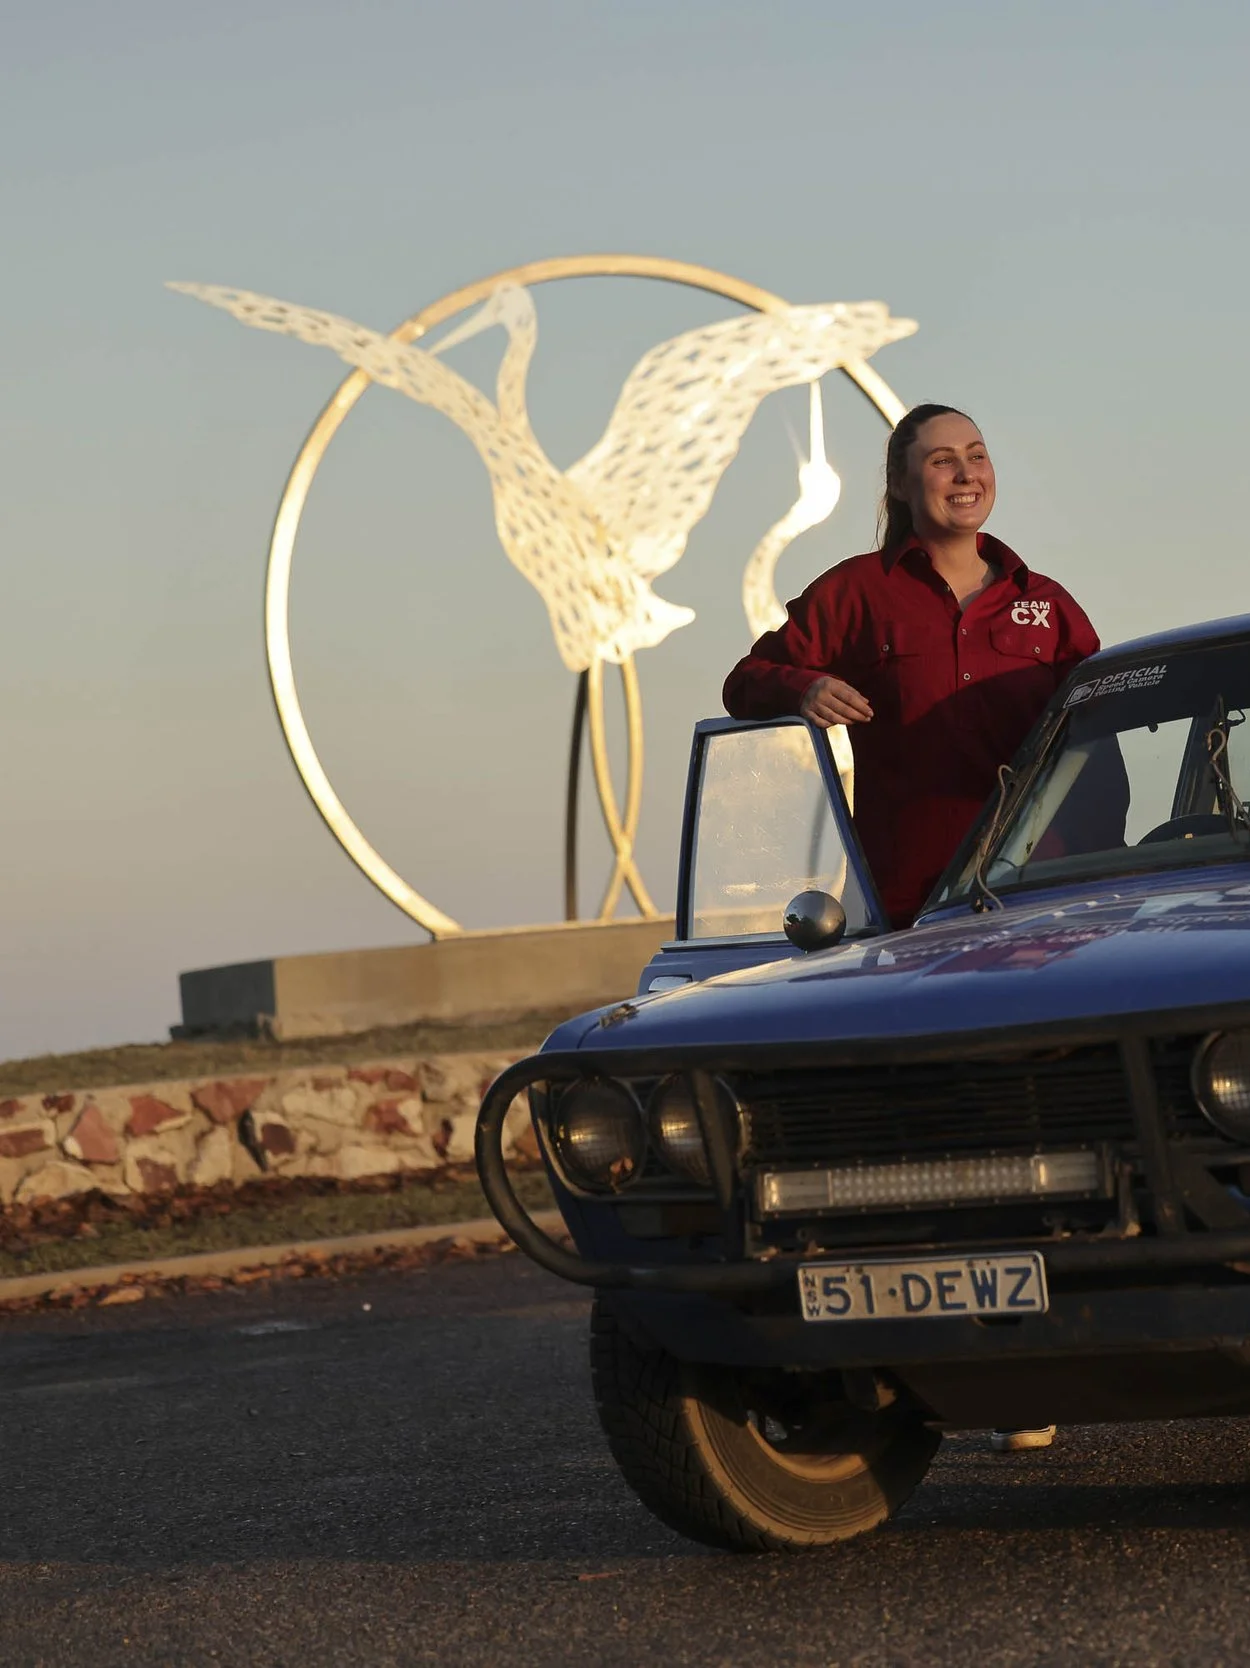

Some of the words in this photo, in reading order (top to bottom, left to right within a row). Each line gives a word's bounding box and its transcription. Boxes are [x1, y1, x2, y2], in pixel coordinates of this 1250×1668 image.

[1013, 601, 1050, 610] TEAM
[1011, 607, 1050, 629] CX
[1101, 665, 1168, 685] OFFICIAL
